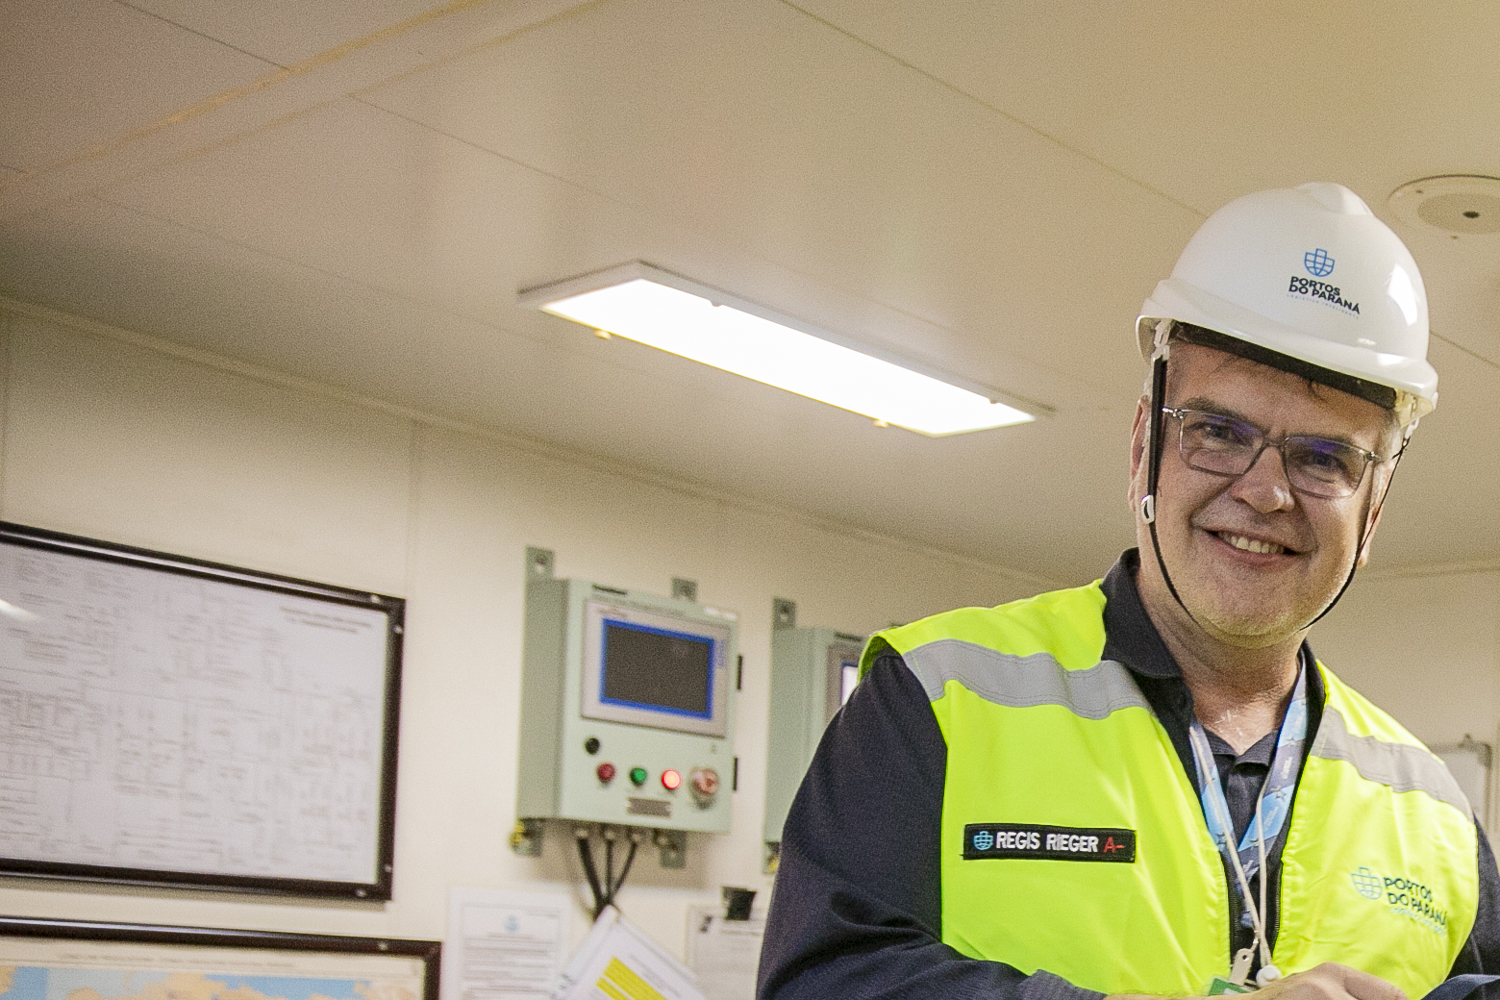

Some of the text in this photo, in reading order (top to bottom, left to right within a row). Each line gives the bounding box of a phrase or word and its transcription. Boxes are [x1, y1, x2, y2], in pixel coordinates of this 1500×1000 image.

[1290, 275, 1341, 297] PORTOS
[1288, 283, 1361, 315] DO PARANÁ
[995, 831, 1125, 853] REGIS RIEGER A-
[1383, 876, 1433, 903] PORTOS
[1387, 892, 1409, 906] DO
